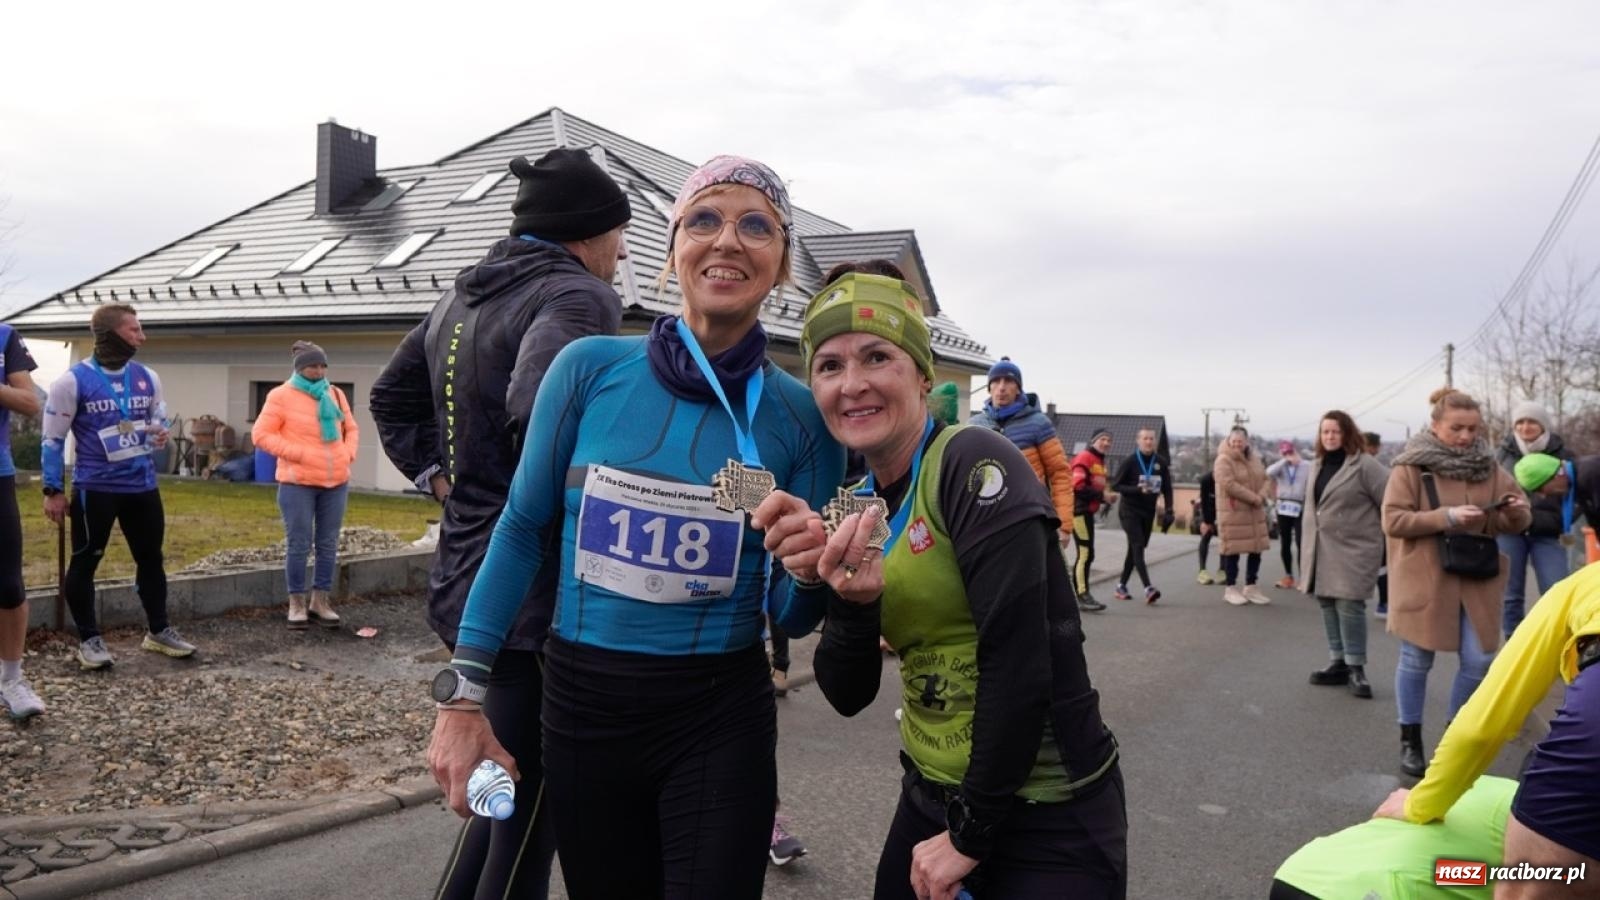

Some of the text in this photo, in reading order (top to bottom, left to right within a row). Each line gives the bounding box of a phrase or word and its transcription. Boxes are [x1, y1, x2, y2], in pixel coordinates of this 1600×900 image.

[618, 480, 640, 492] Cross
[640, 485, 652, 495] po
[652, 487, 677, 499] Ziemi
[608, 508, 711, 570] 118
